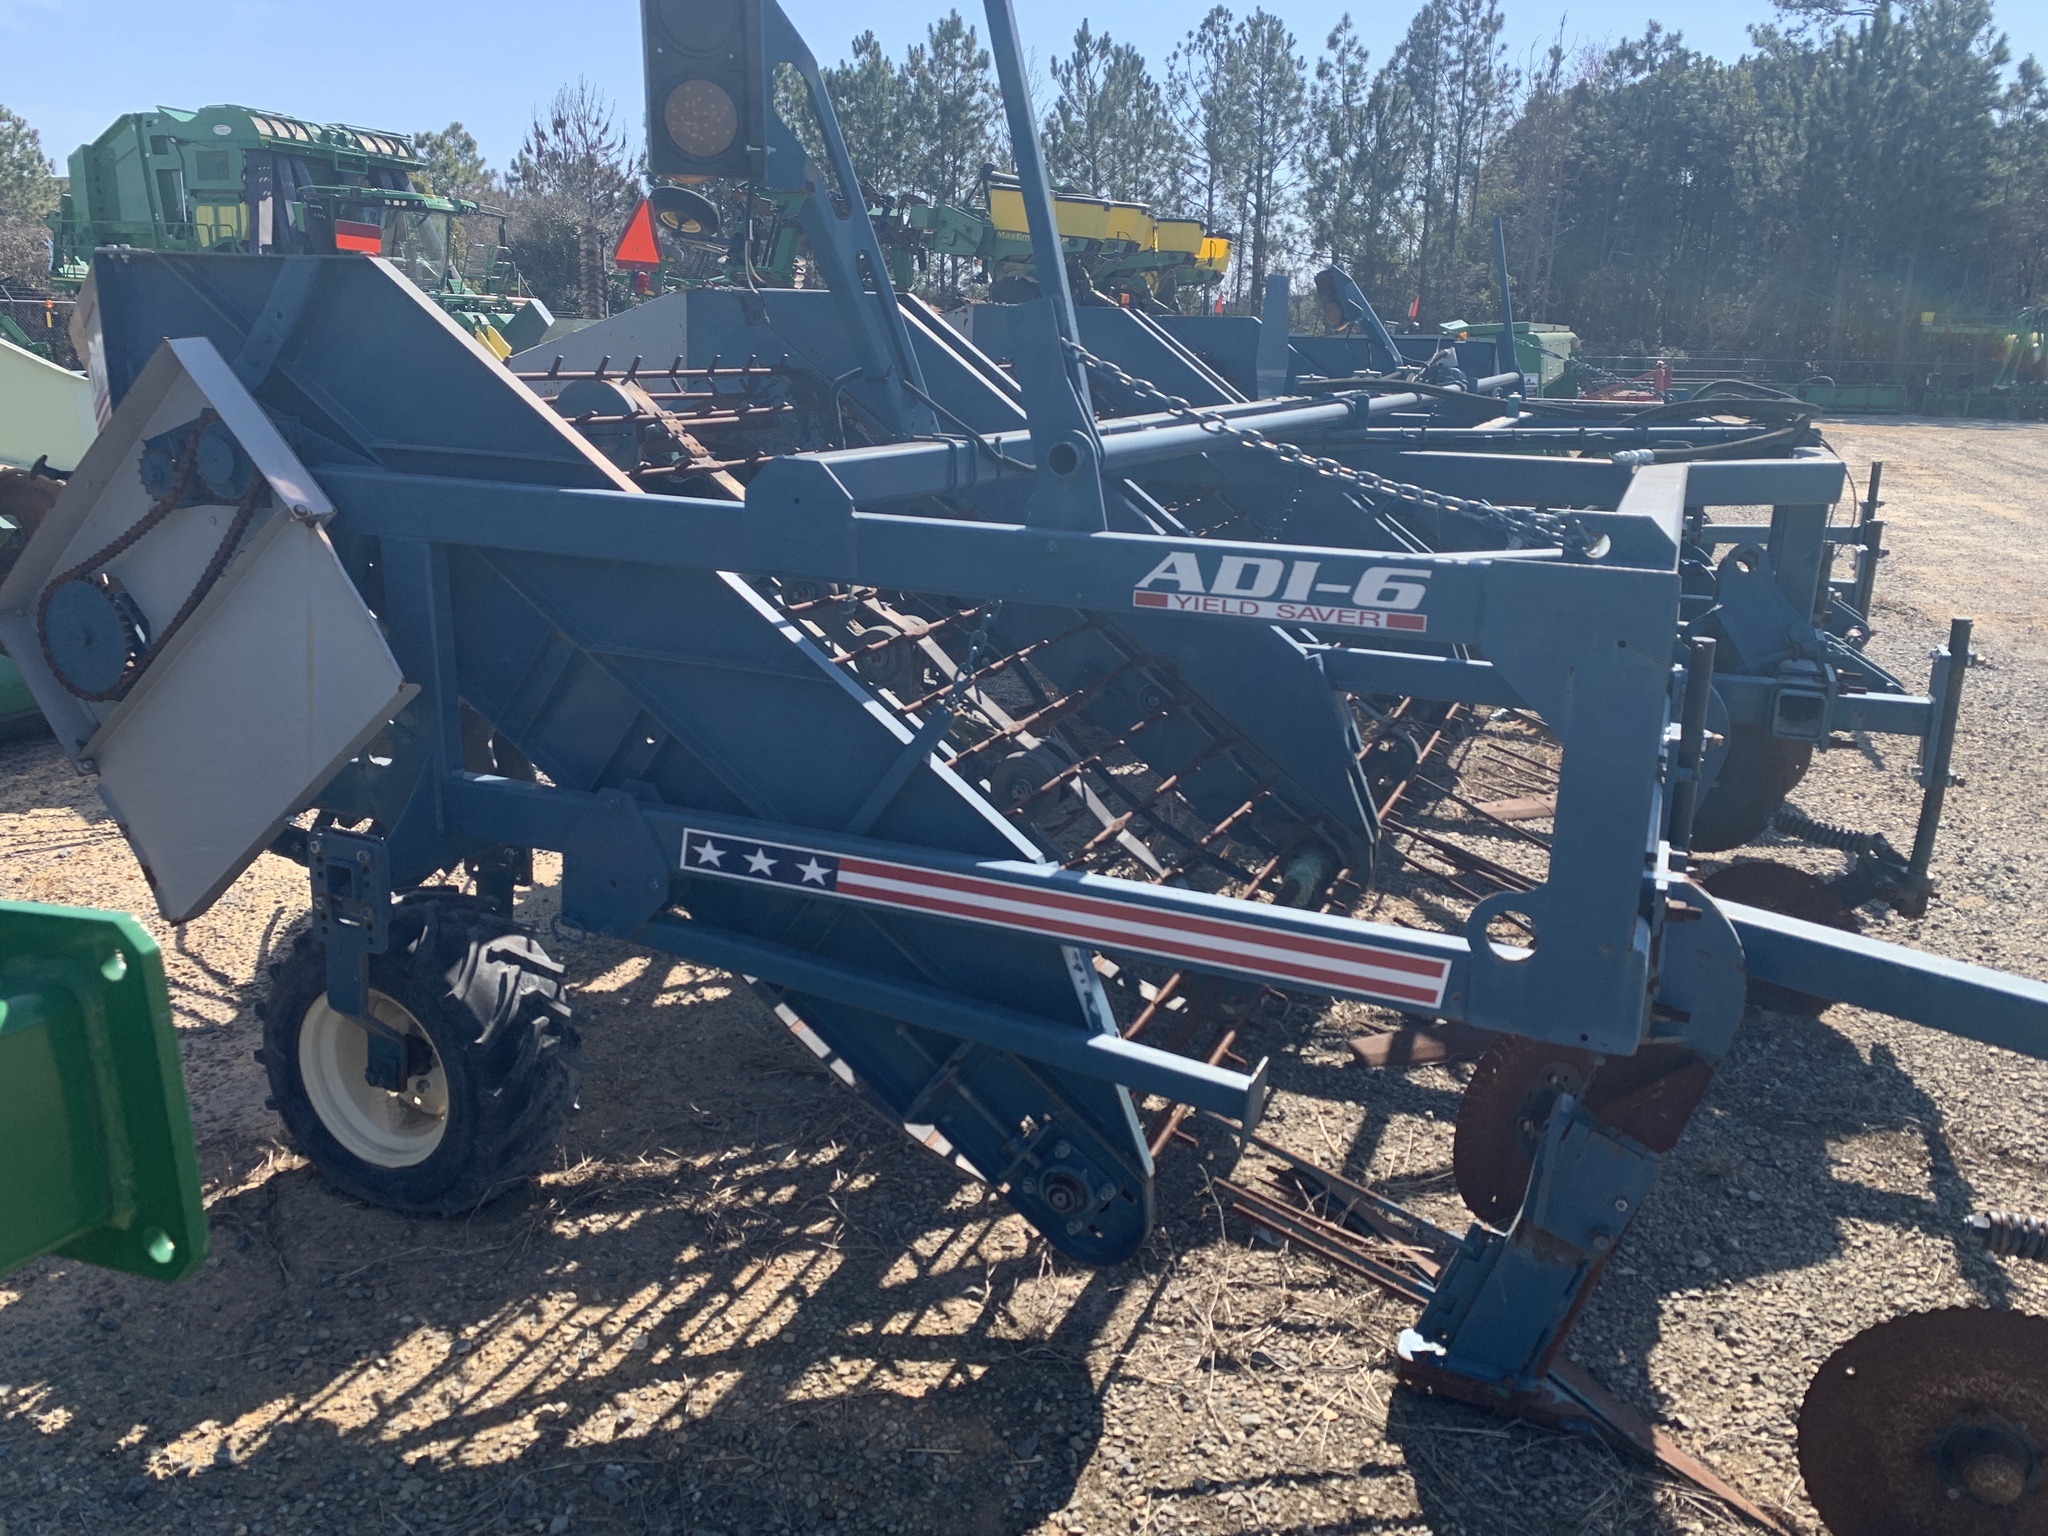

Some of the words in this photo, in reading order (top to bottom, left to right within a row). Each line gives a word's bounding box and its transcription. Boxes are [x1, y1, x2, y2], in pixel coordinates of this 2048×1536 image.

[997, 230, 1030, 241] MaxEm
[1134, 551, 1432, 610] ADI-6
[1174, 595, 1259, 616] YIELD
[1276, 604, 1381, 627] SAVER
